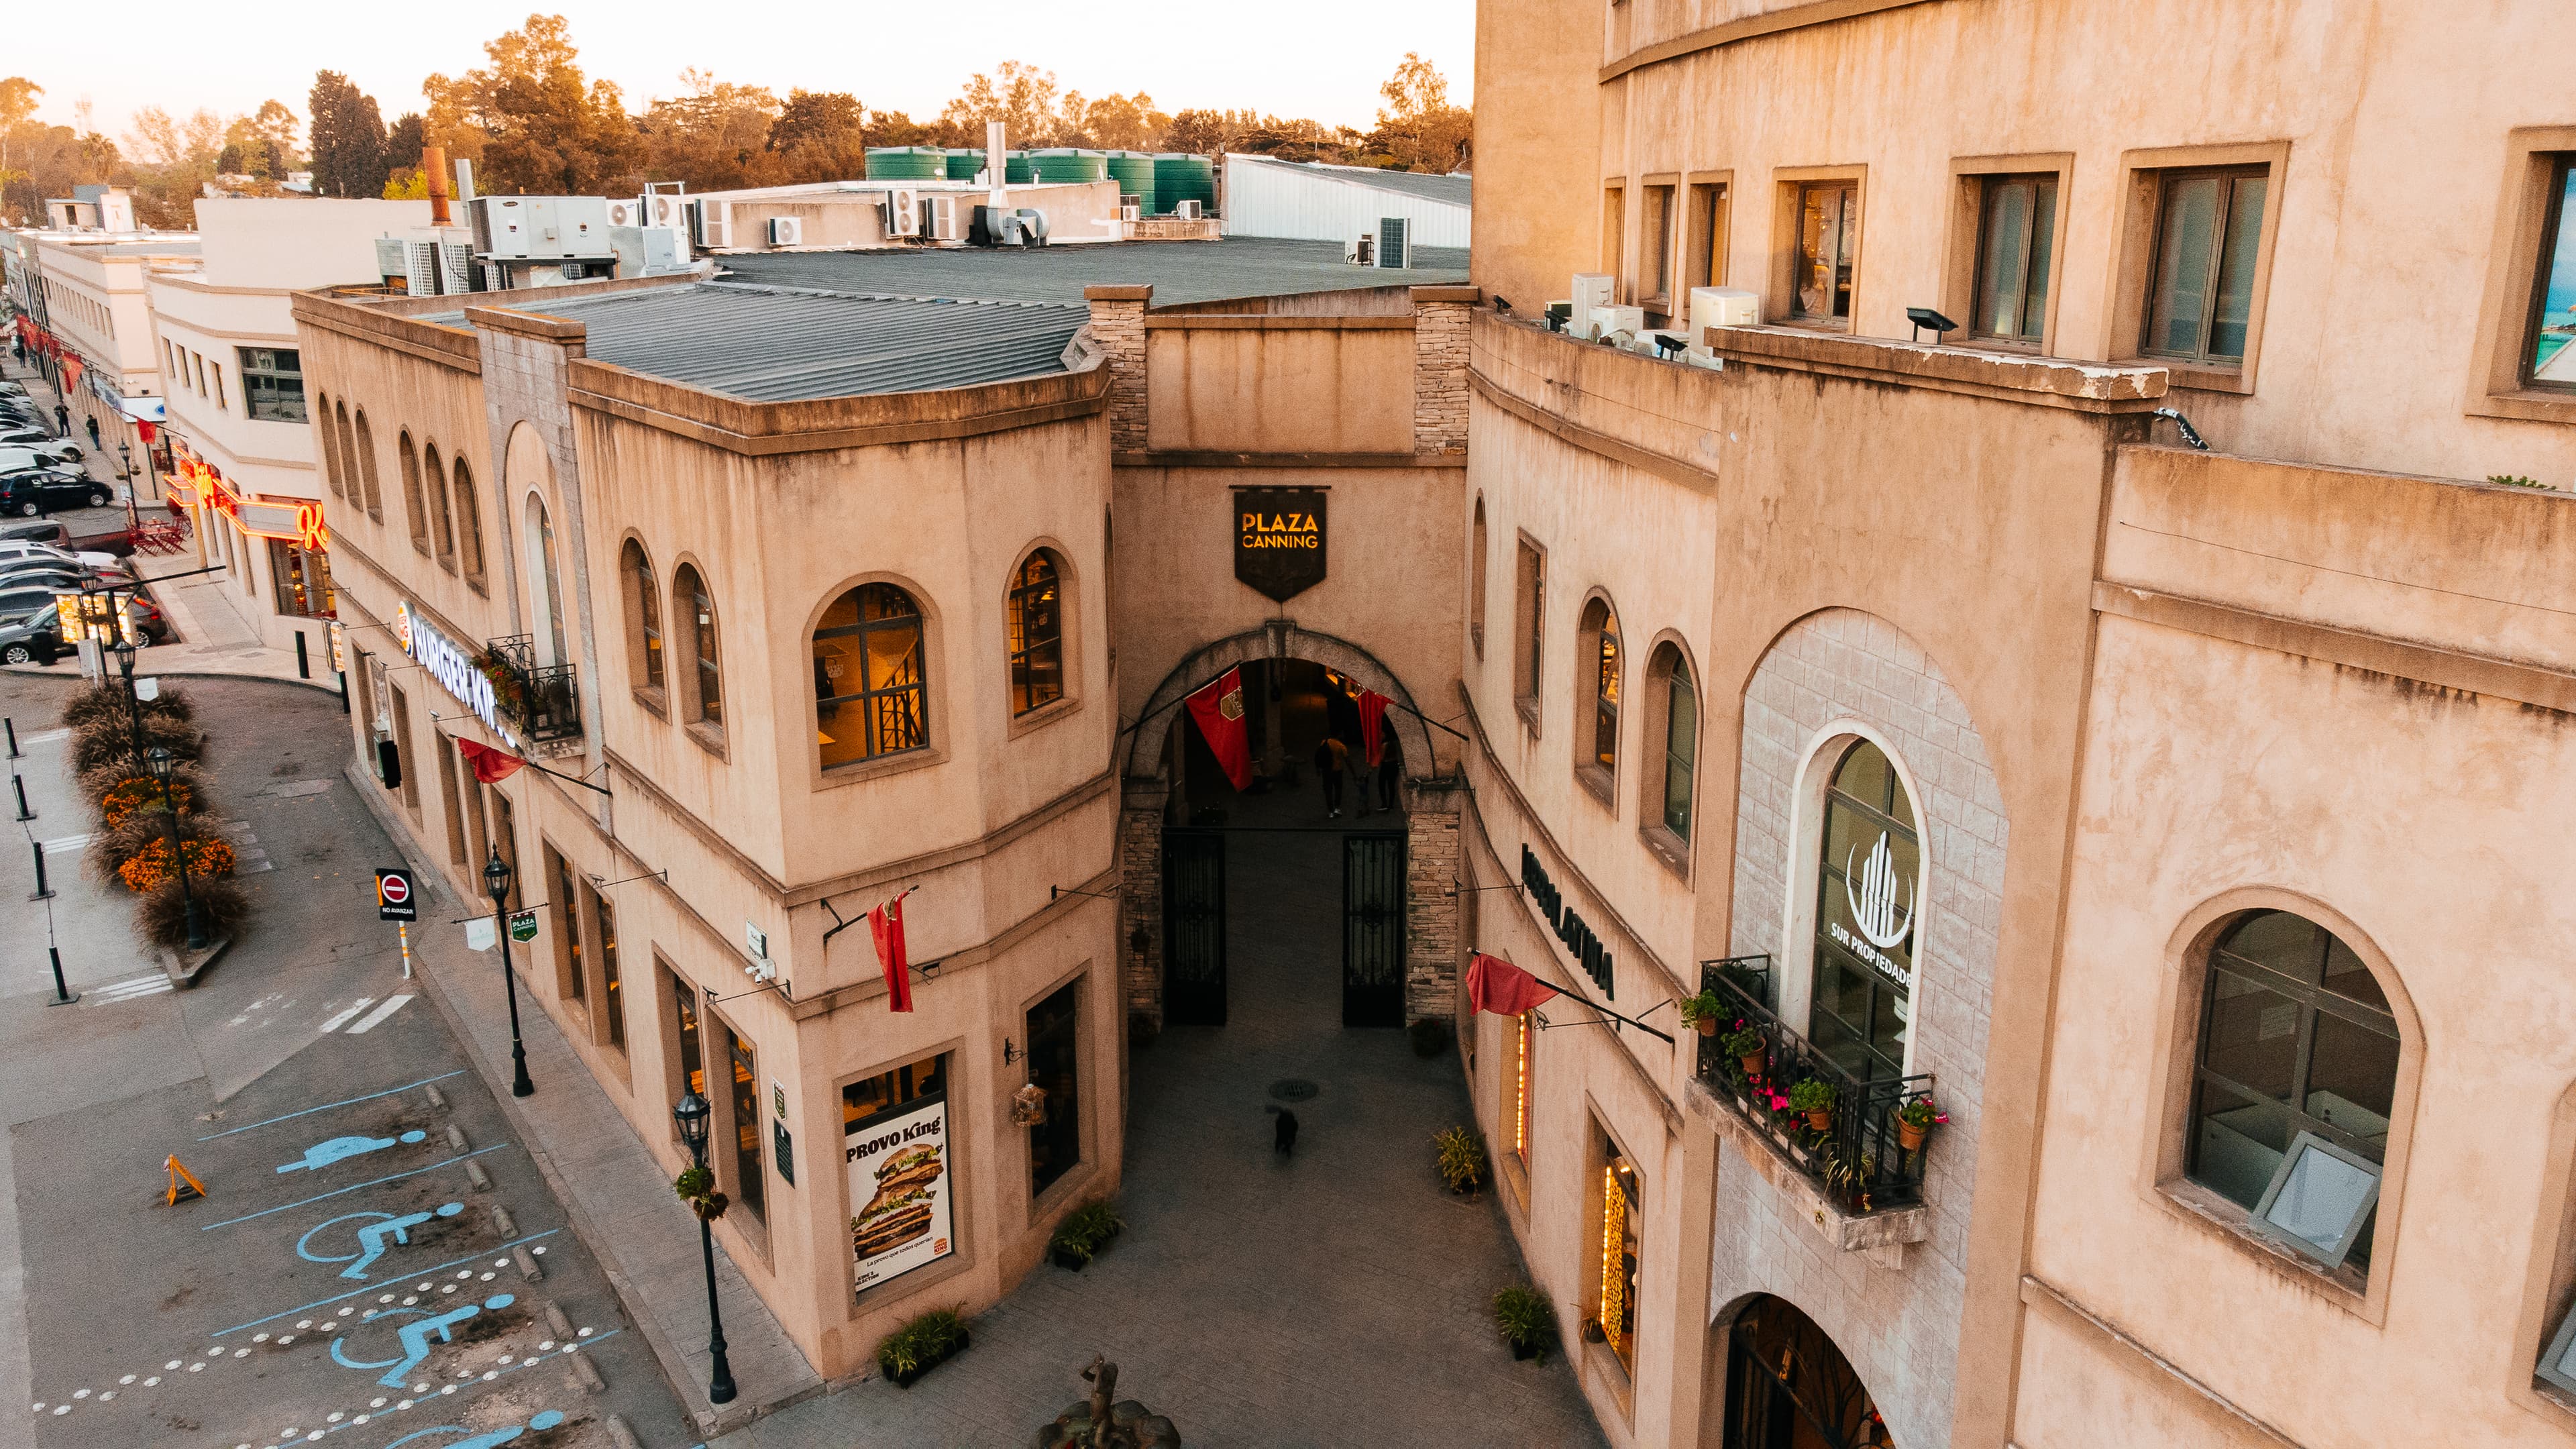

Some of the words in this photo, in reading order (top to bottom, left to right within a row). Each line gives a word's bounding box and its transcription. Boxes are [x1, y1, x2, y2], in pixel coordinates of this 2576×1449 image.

[1242, 513, 1319, 532] PLAZA
[1242, 535, 1318, 549] CANNING
[413, 616, 471, 708] BURGER
[513, 918, 535, 927] PLAZA
[1831, 922, 1849, 946] SUR
[847, 1132, 901, 1163] PROVO
[903, 1116, 941, 1142] King
[873, 1255, 889, 1265] provo
[899, 1244, 914, 1254] todos
[934, 1245, 947, 1253] KING
